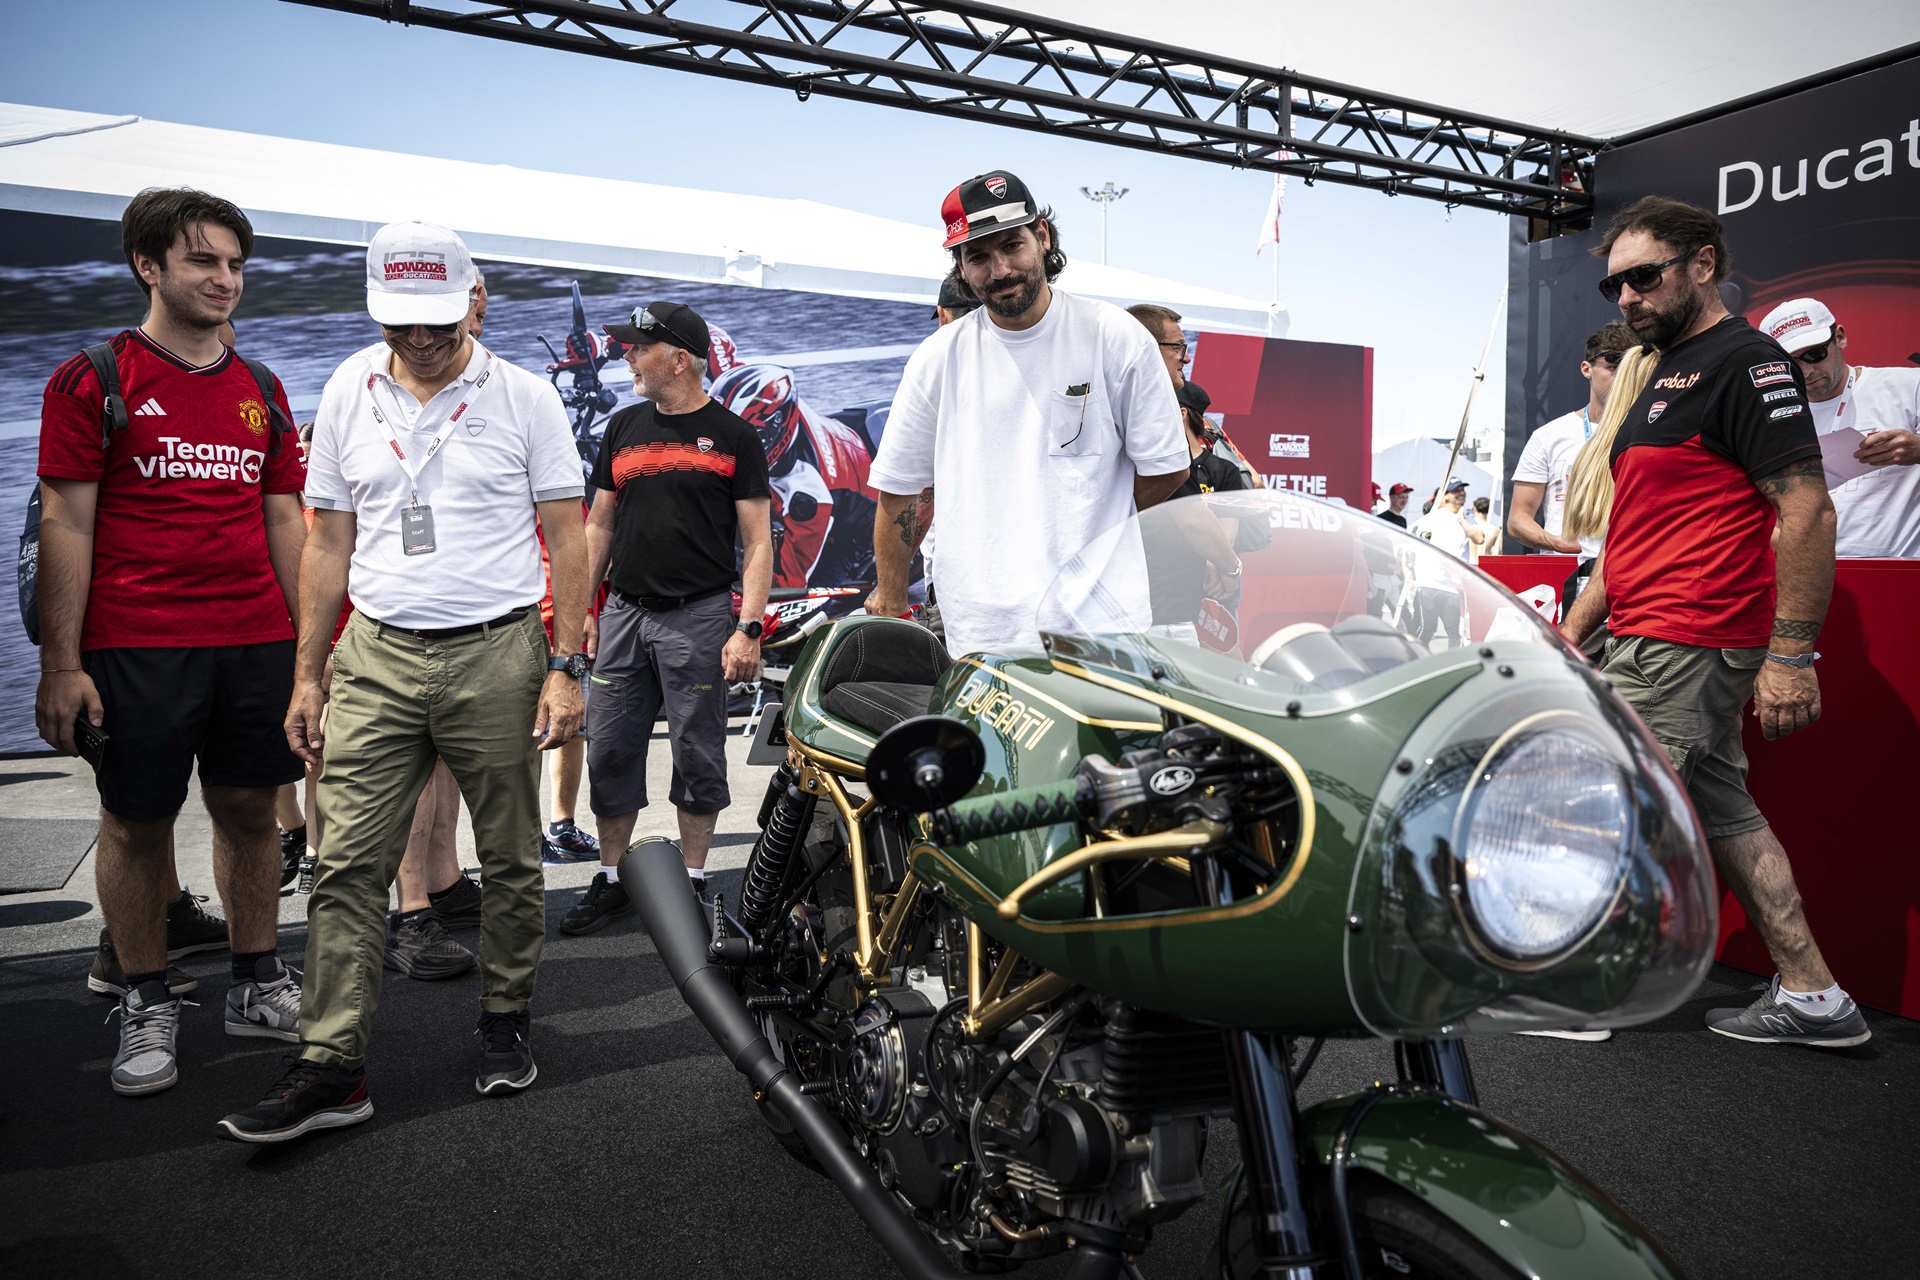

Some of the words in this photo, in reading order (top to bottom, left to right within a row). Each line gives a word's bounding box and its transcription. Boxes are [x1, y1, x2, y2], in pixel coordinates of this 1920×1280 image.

[1718, 119, 1920, 215] Ducat
[384, 262, 447, 274] WDW2026
[1763, 388, 1798, 402] PIRELLI
[158, 436, 239, 463] Team
[133, 455, 240, 481] Viewer
[1289, 474, 1327, 495] THE
[956, 677, 1055, 751] DUCATI
